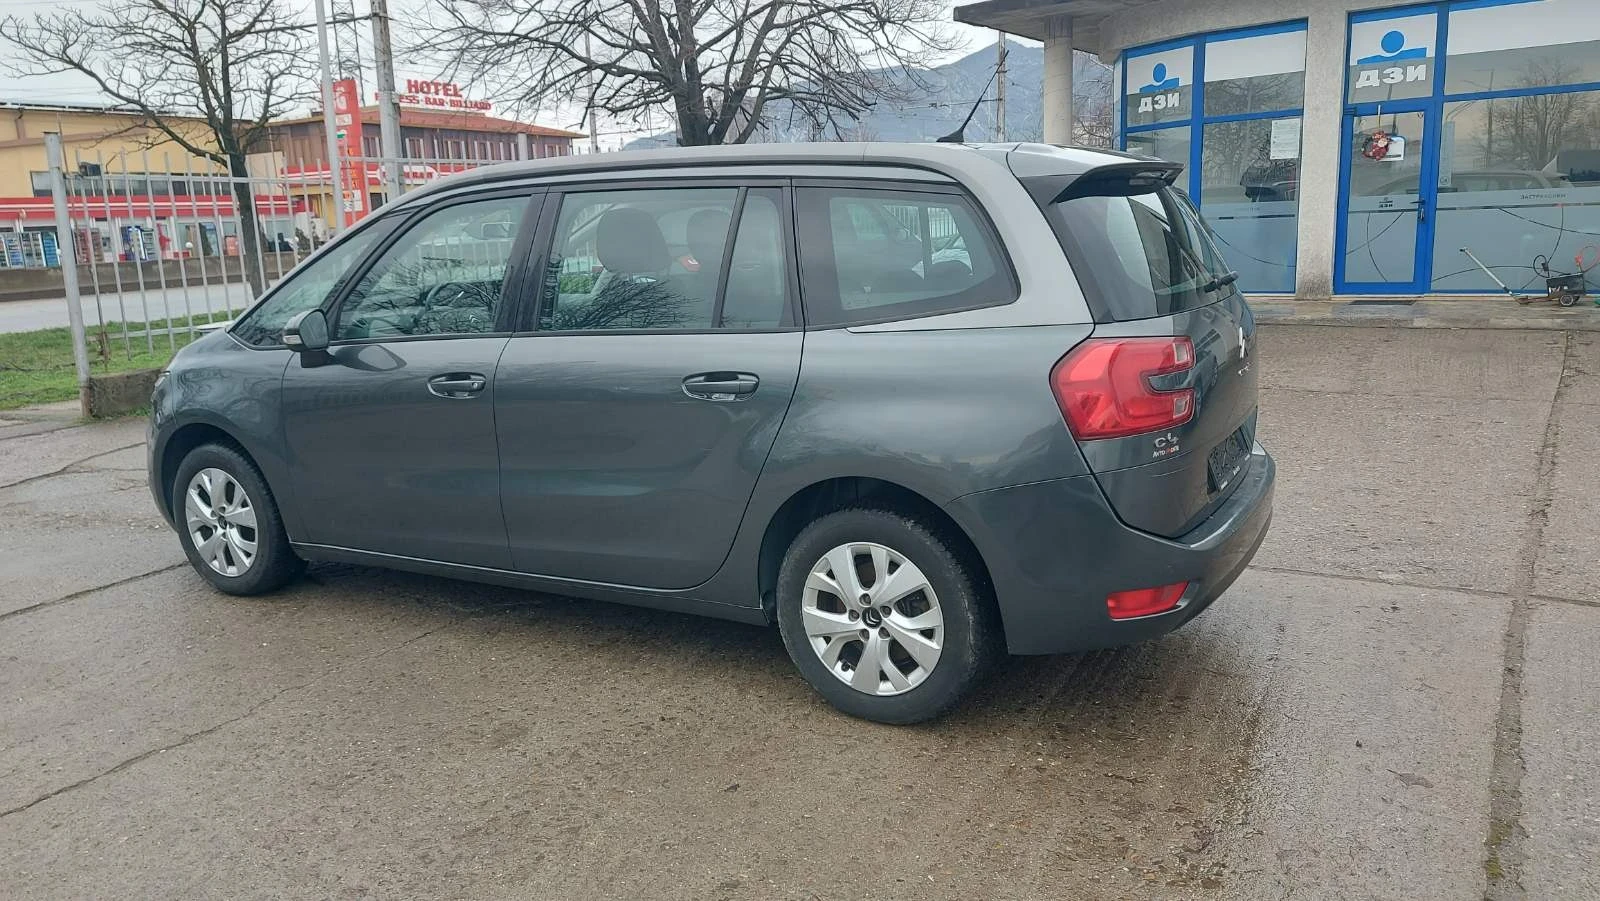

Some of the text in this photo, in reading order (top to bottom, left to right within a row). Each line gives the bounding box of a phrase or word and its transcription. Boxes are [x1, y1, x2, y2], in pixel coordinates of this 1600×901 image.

[1355, 64, 1427, 88] ДЗИ
[406, 79, 463, 98] HOTEL
[424, 97, 445, 107] BAR
[449, 99, 492, 111] BILLIARD
[1138, 92, 1180, 113] ДЗИ
[1154, 432, 1179, 448] C4
